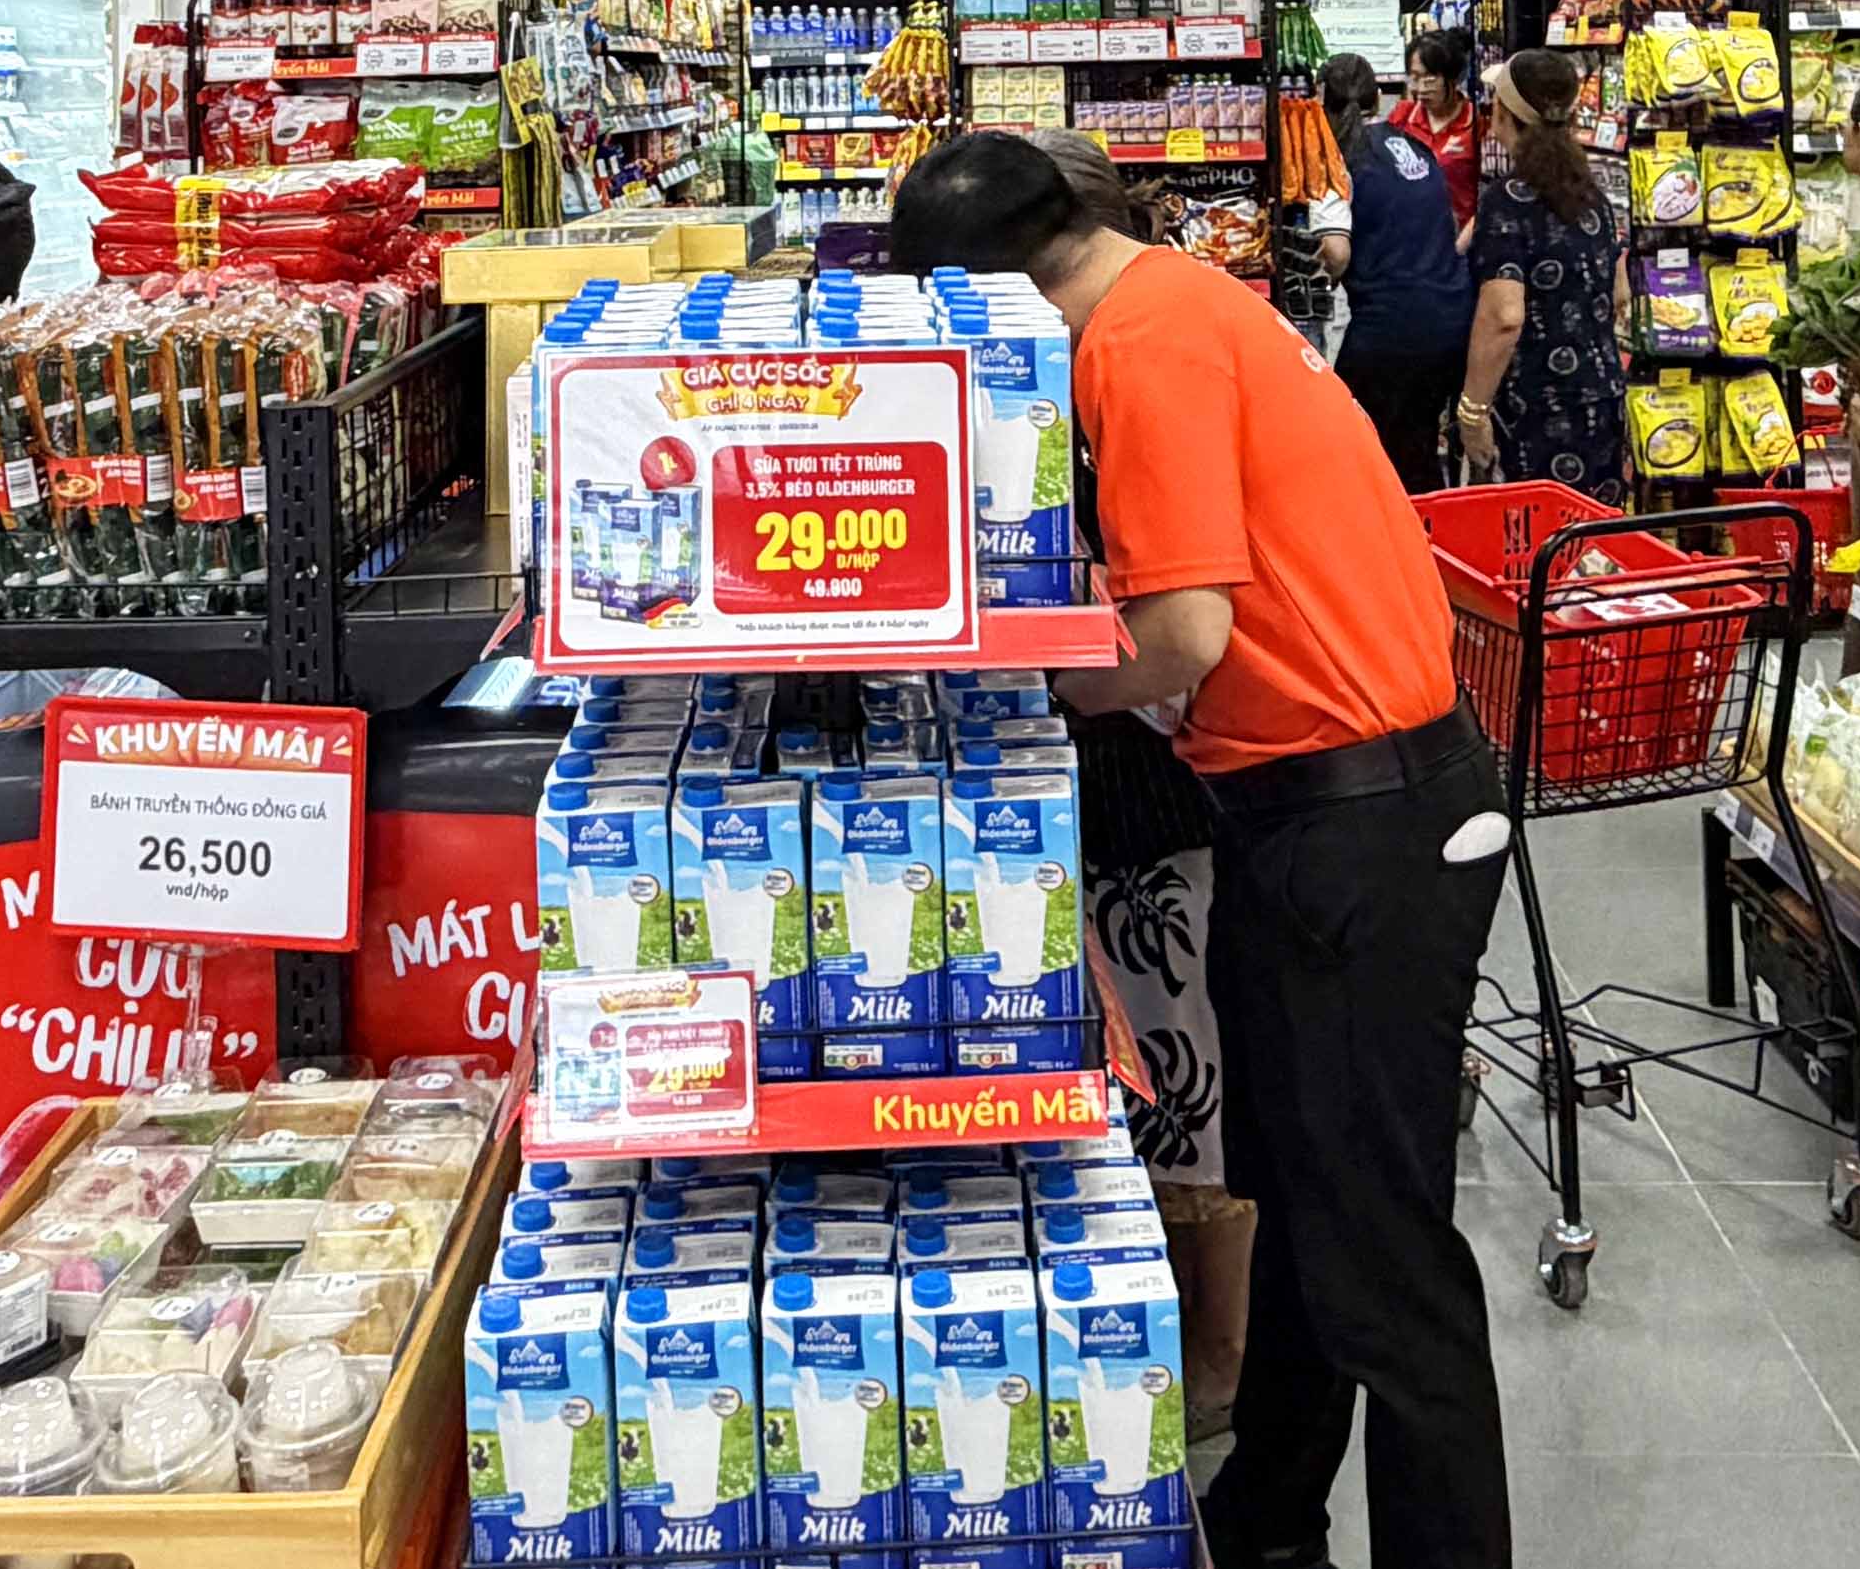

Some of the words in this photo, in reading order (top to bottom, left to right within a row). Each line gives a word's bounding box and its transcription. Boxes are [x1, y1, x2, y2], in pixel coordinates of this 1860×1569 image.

[683, 365, 723, 385] GIÁ
[783, 358, 831, 383] SỐC
[816, 479, 915, 496] OLDENBURGER
[756, 509, 907, 571] 29.000
[95, 716, 242, 755] KHUYẾN
[252, 729, 324, 766] MÃI
[90, 793, 131, 810] BÁNH
[134, 794, 190, 815] TRUYỀN
[301, 802, 327, 820] GIÁ
[138, 836, 272, 877] 26,500
[166, 883, 229, 901] vnd/hộp
[387, 898, 491, 977] MÁT
[847, 996, 913, 1022] Milk
[981, 995, 1047, 1021] Milk
[874, 1087, 1020, 1136] Khuyến
[943, 1511, 1009, 1538] Milk
[1086, 1502, 1152, 1529] Milk
[654, 1526, 721, 1553] Milk
[799, 1516, 866, 1543] Milk
[505, 1534, 572, 1562] Milk
